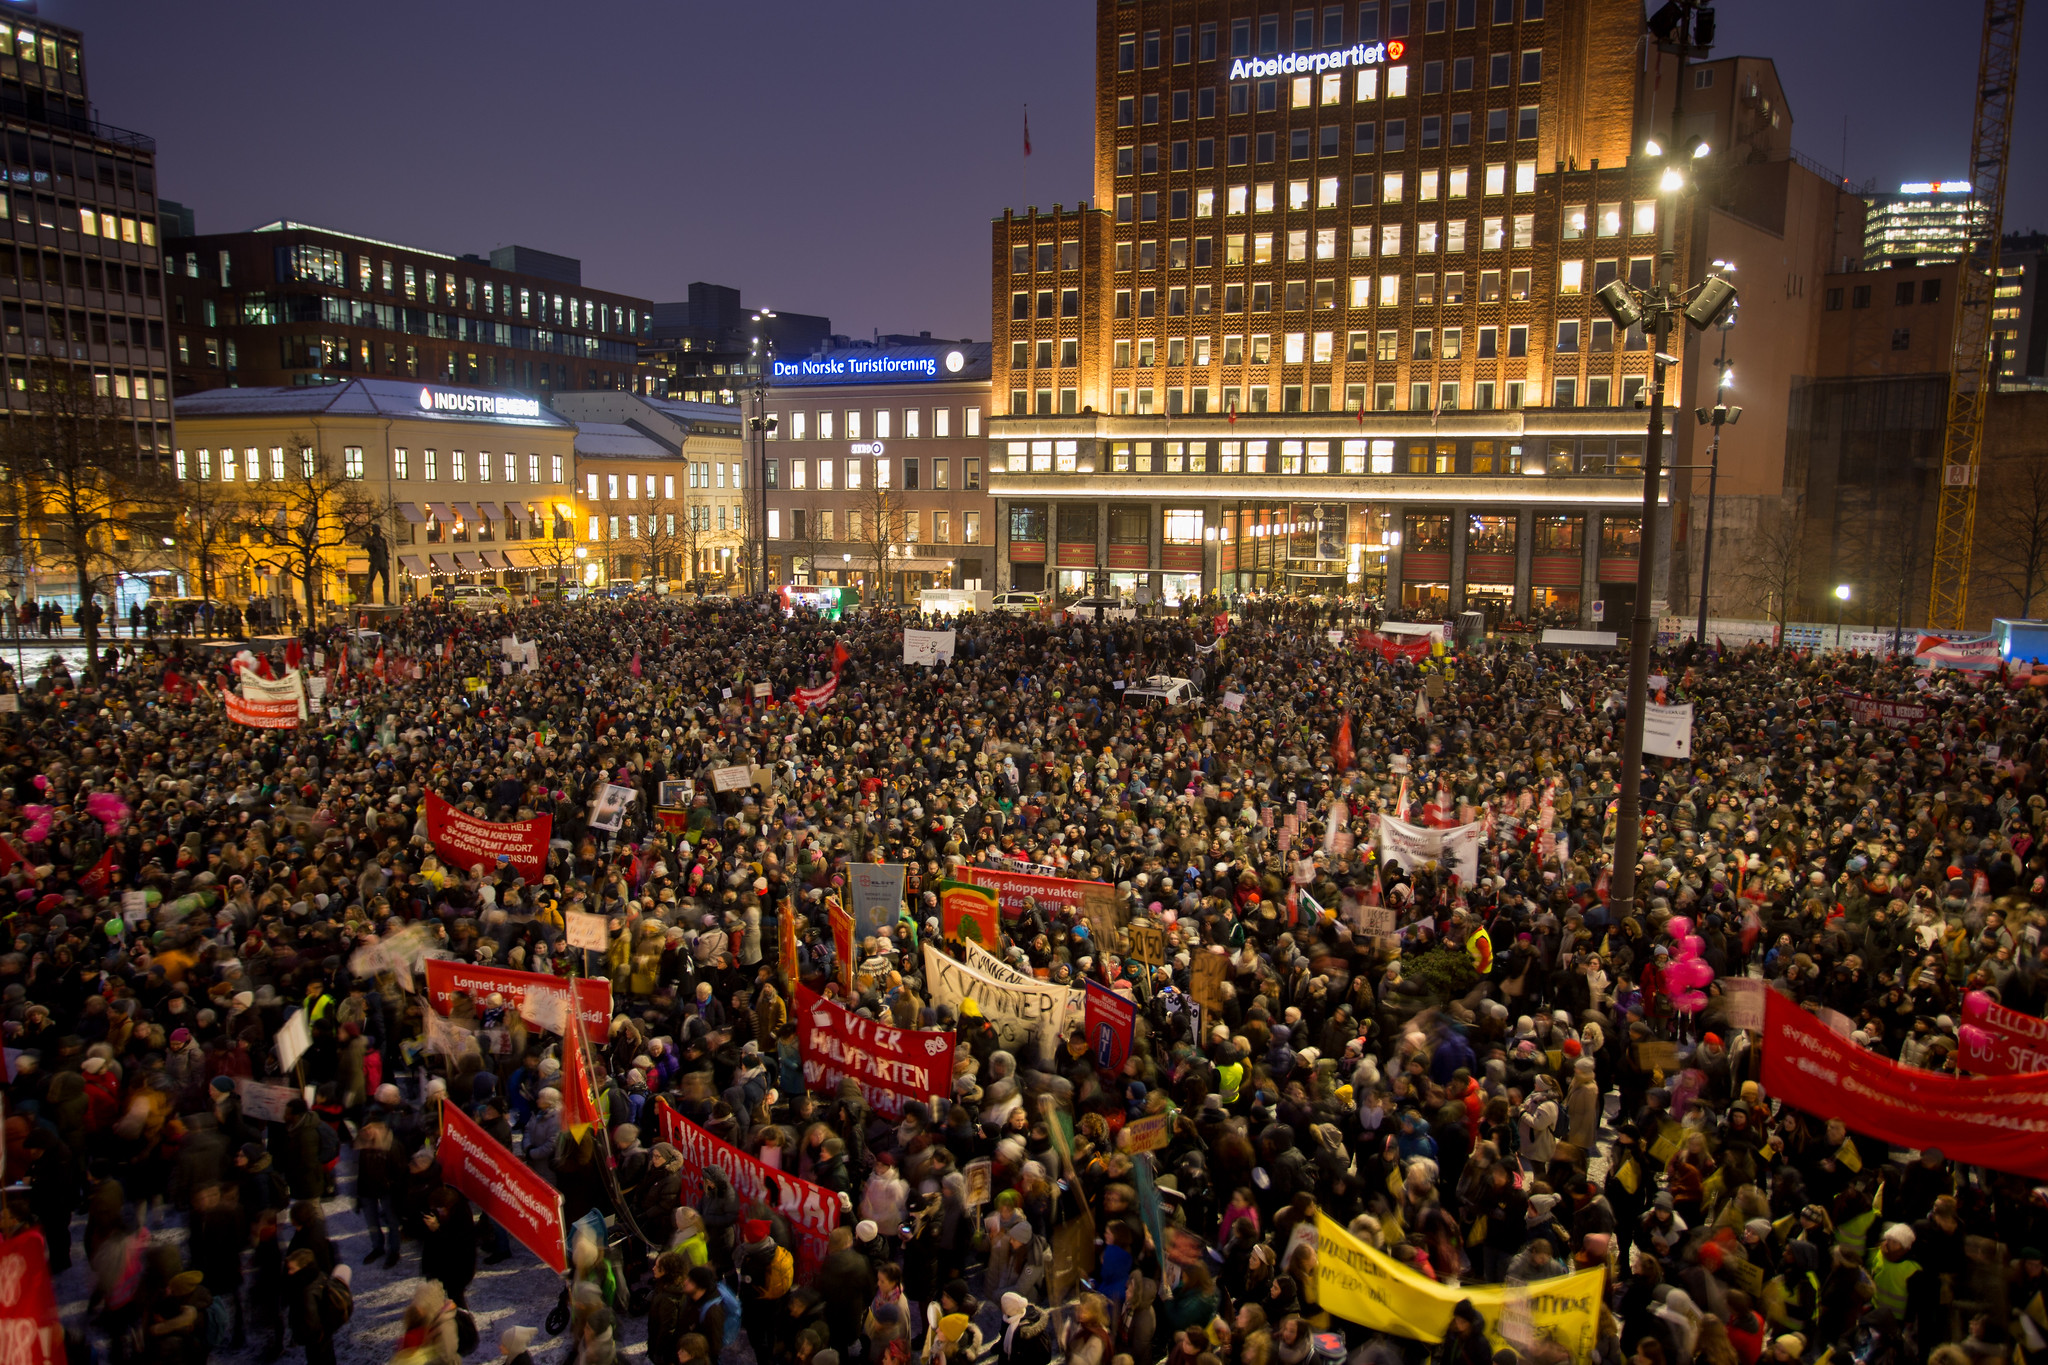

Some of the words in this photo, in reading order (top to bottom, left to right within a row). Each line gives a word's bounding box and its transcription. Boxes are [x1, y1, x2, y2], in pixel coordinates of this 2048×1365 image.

[1230, 42, 1385, 80] Arbeiderpartiet
[774, 361, 798, 376] Den
[802, 358, 844, 375] Norske
[848, 356, 936, 376] Turistforening
[434, 392, 494, 413] INDUSTRI
[455, 820, 489, 838] VERDEN
[490, 830, 524, 842] KREVER
[483, 850, 538, 864] PREENSJON
[503, 843, 533, 853] ABORT
[977, 877, 1001, 890] Ikke
[1003, 880, 1044, 896] shoppe
[1047, 886, 1084, 899] vakter
[1130, 930, 1162, 959] 50/50
[453, 974, 495, 992] Lønnet
[844, 1012, 867, 1040] VI
[873, 1026, 904, 1054] ER
[1098, 1026, 1112, 1066] NTL
[809, 1027, 930, 1092] HALVPARTEN
